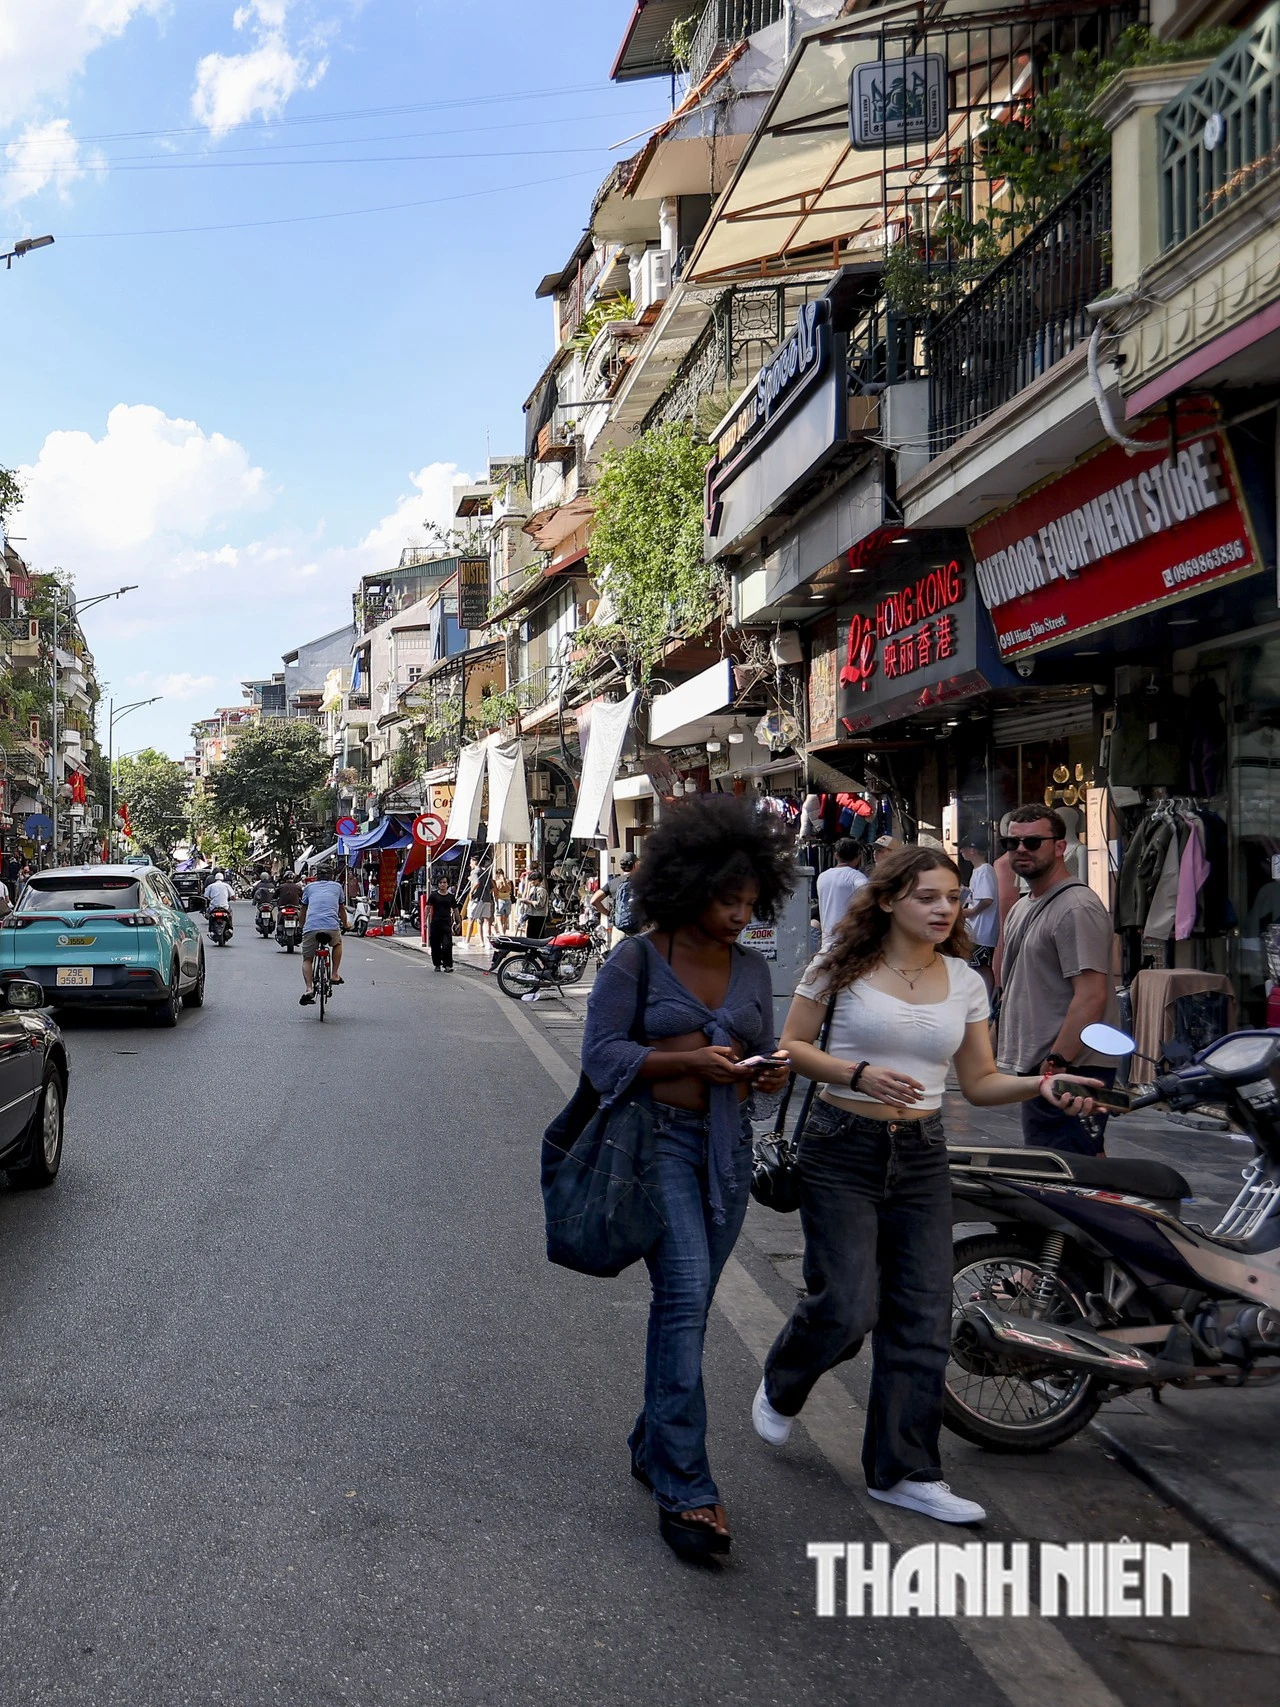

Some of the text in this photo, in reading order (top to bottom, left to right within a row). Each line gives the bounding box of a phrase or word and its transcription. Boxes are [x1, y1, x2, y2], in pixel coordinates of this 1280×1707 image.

[975, 440, 1220, 610] OUTDOOR EQUIPMENT STORE
[461, 562, 488, 584] HOSTEL
[1172, 539, 1244, 583] 0969863836
[876, 559, 961, 640] HONG KONG
[883, 613, 953, 679] 映丽香港
[1005, 631, 1016, 647] 91
[1043, 613, 1067, 631] Street
[751, 929, 773, 940] 200K
[60, 976, 89, 985] 358.31
[67, 968, 83, 977] 29E
